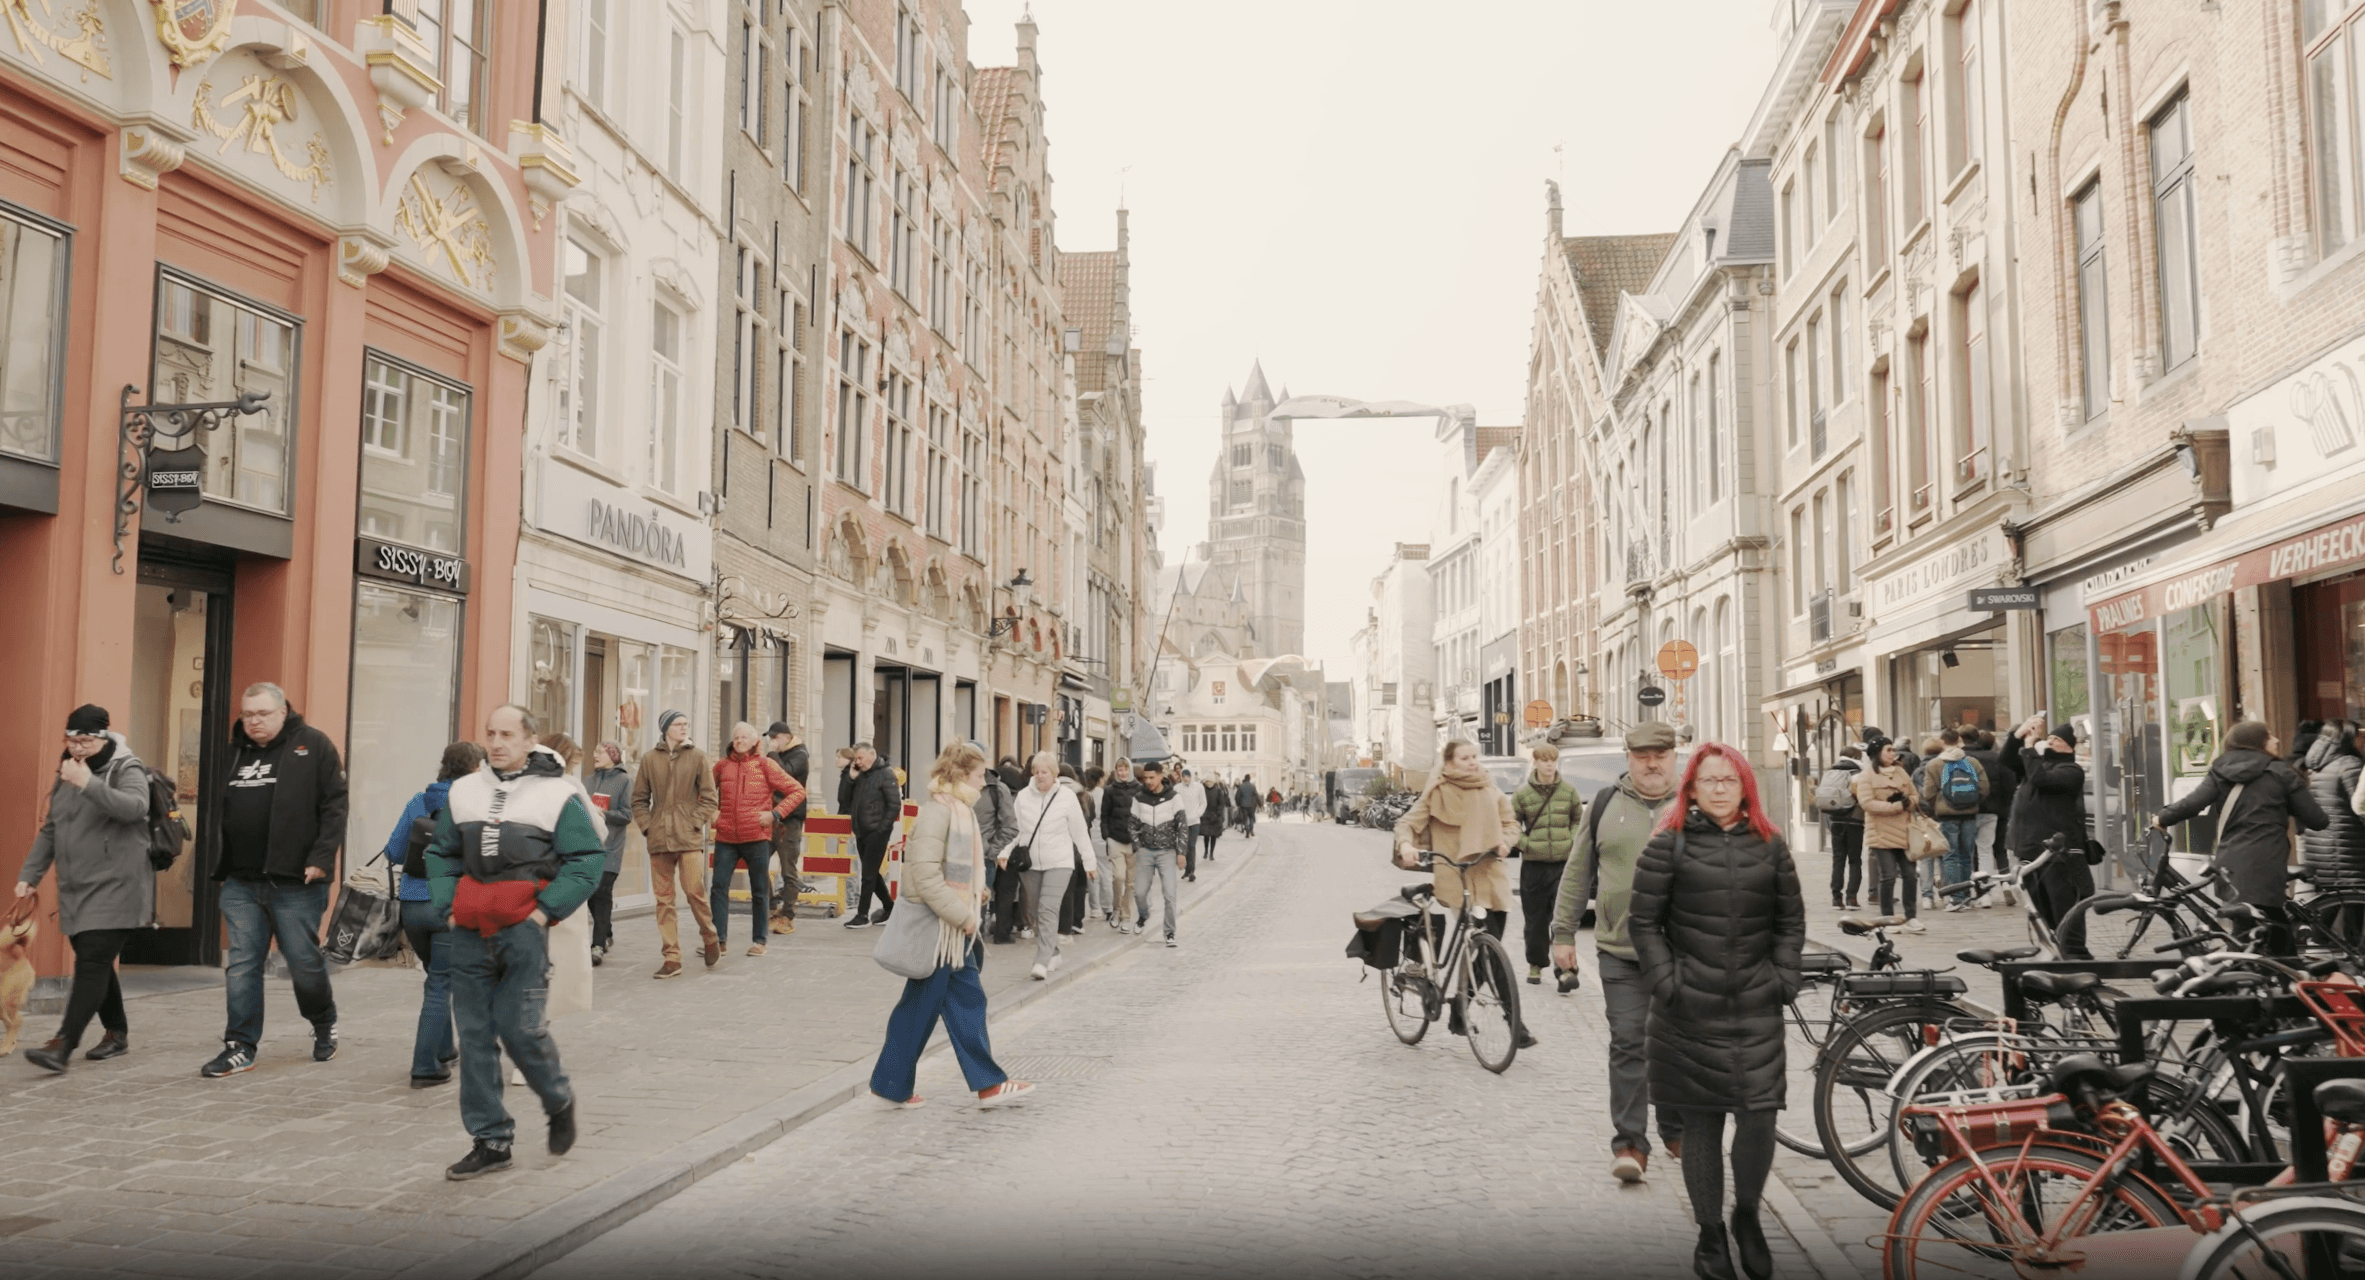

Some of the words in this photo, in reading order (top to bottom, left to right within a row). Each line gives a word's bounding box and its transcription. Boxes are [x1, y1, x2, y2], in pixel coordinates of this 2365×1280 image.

[153, 472, 198, 486] SISSY-BOY
[589, 498, 686, 568] PANDORA
[379, 546, 461, 588] SISSY-BOY
[1885, 571, 1918, 604] PARIS
[1924, 536, 1988, 588] LONDRES
[2096, 594, 2145, 632] PRALINES
[2165, 561, 2240, 611] CONFISERIE
[2269, 521, 2365, 579] VERHEECK
[1988, 594, 2035, 604] SWAROVSKI
[481, 826, 500, 857] JEANS
